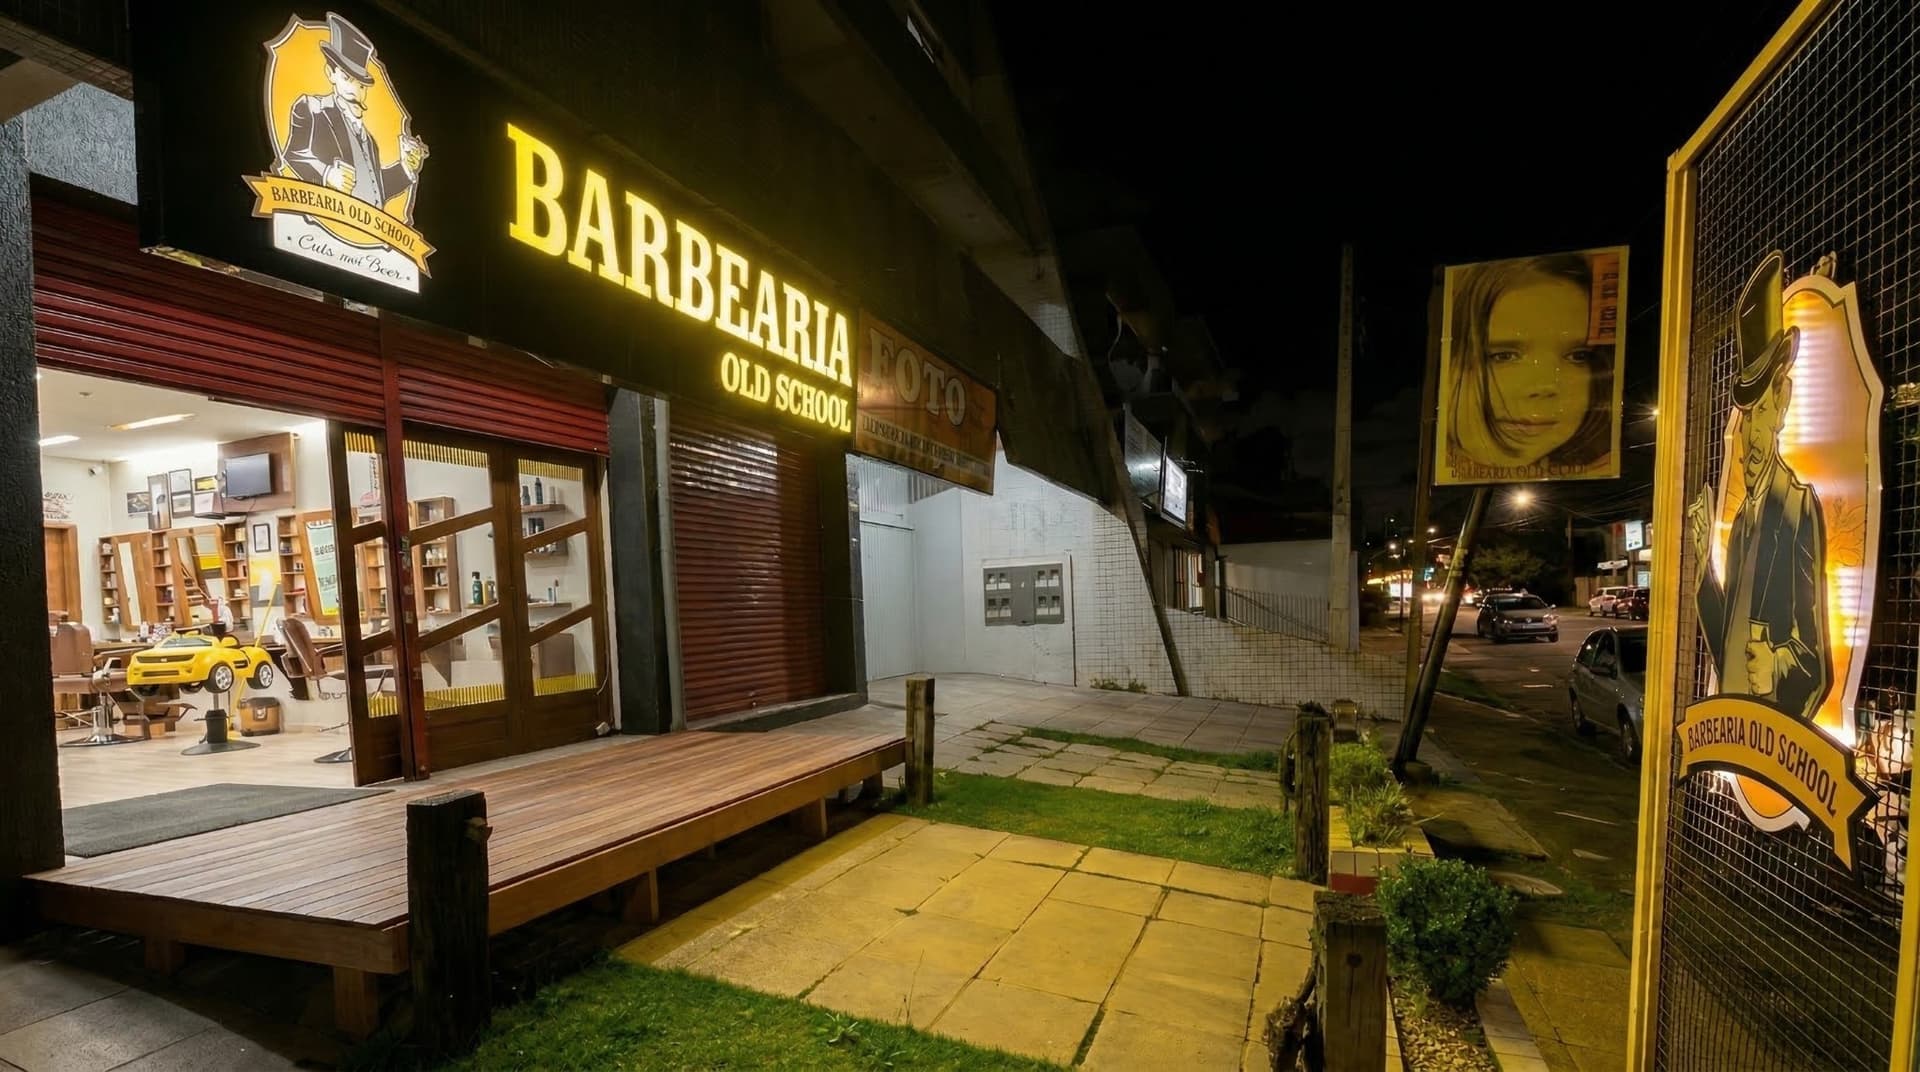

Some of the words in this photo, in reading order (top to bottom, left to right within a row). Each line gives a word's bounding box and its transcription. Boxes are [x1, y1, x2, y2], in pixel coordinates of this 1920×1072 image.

[271, 186, 344, 214] BARBEARIA
[349, 205, 371, 225] OLD
[374, 216, 416, 251] SCHOOL
[507, 122, 852, 387] BARBEARIA
[720, 352, 771, 403] OLD
[775, 374, 851, 432] SCHOOL
[869, 327, 966, 426] FOTO
[1687, 716, 1745, 753] BARBEARIA
[1749, 719, 1774, 757] OLD
[1777, 734, 1838, 815] SCHOOL
